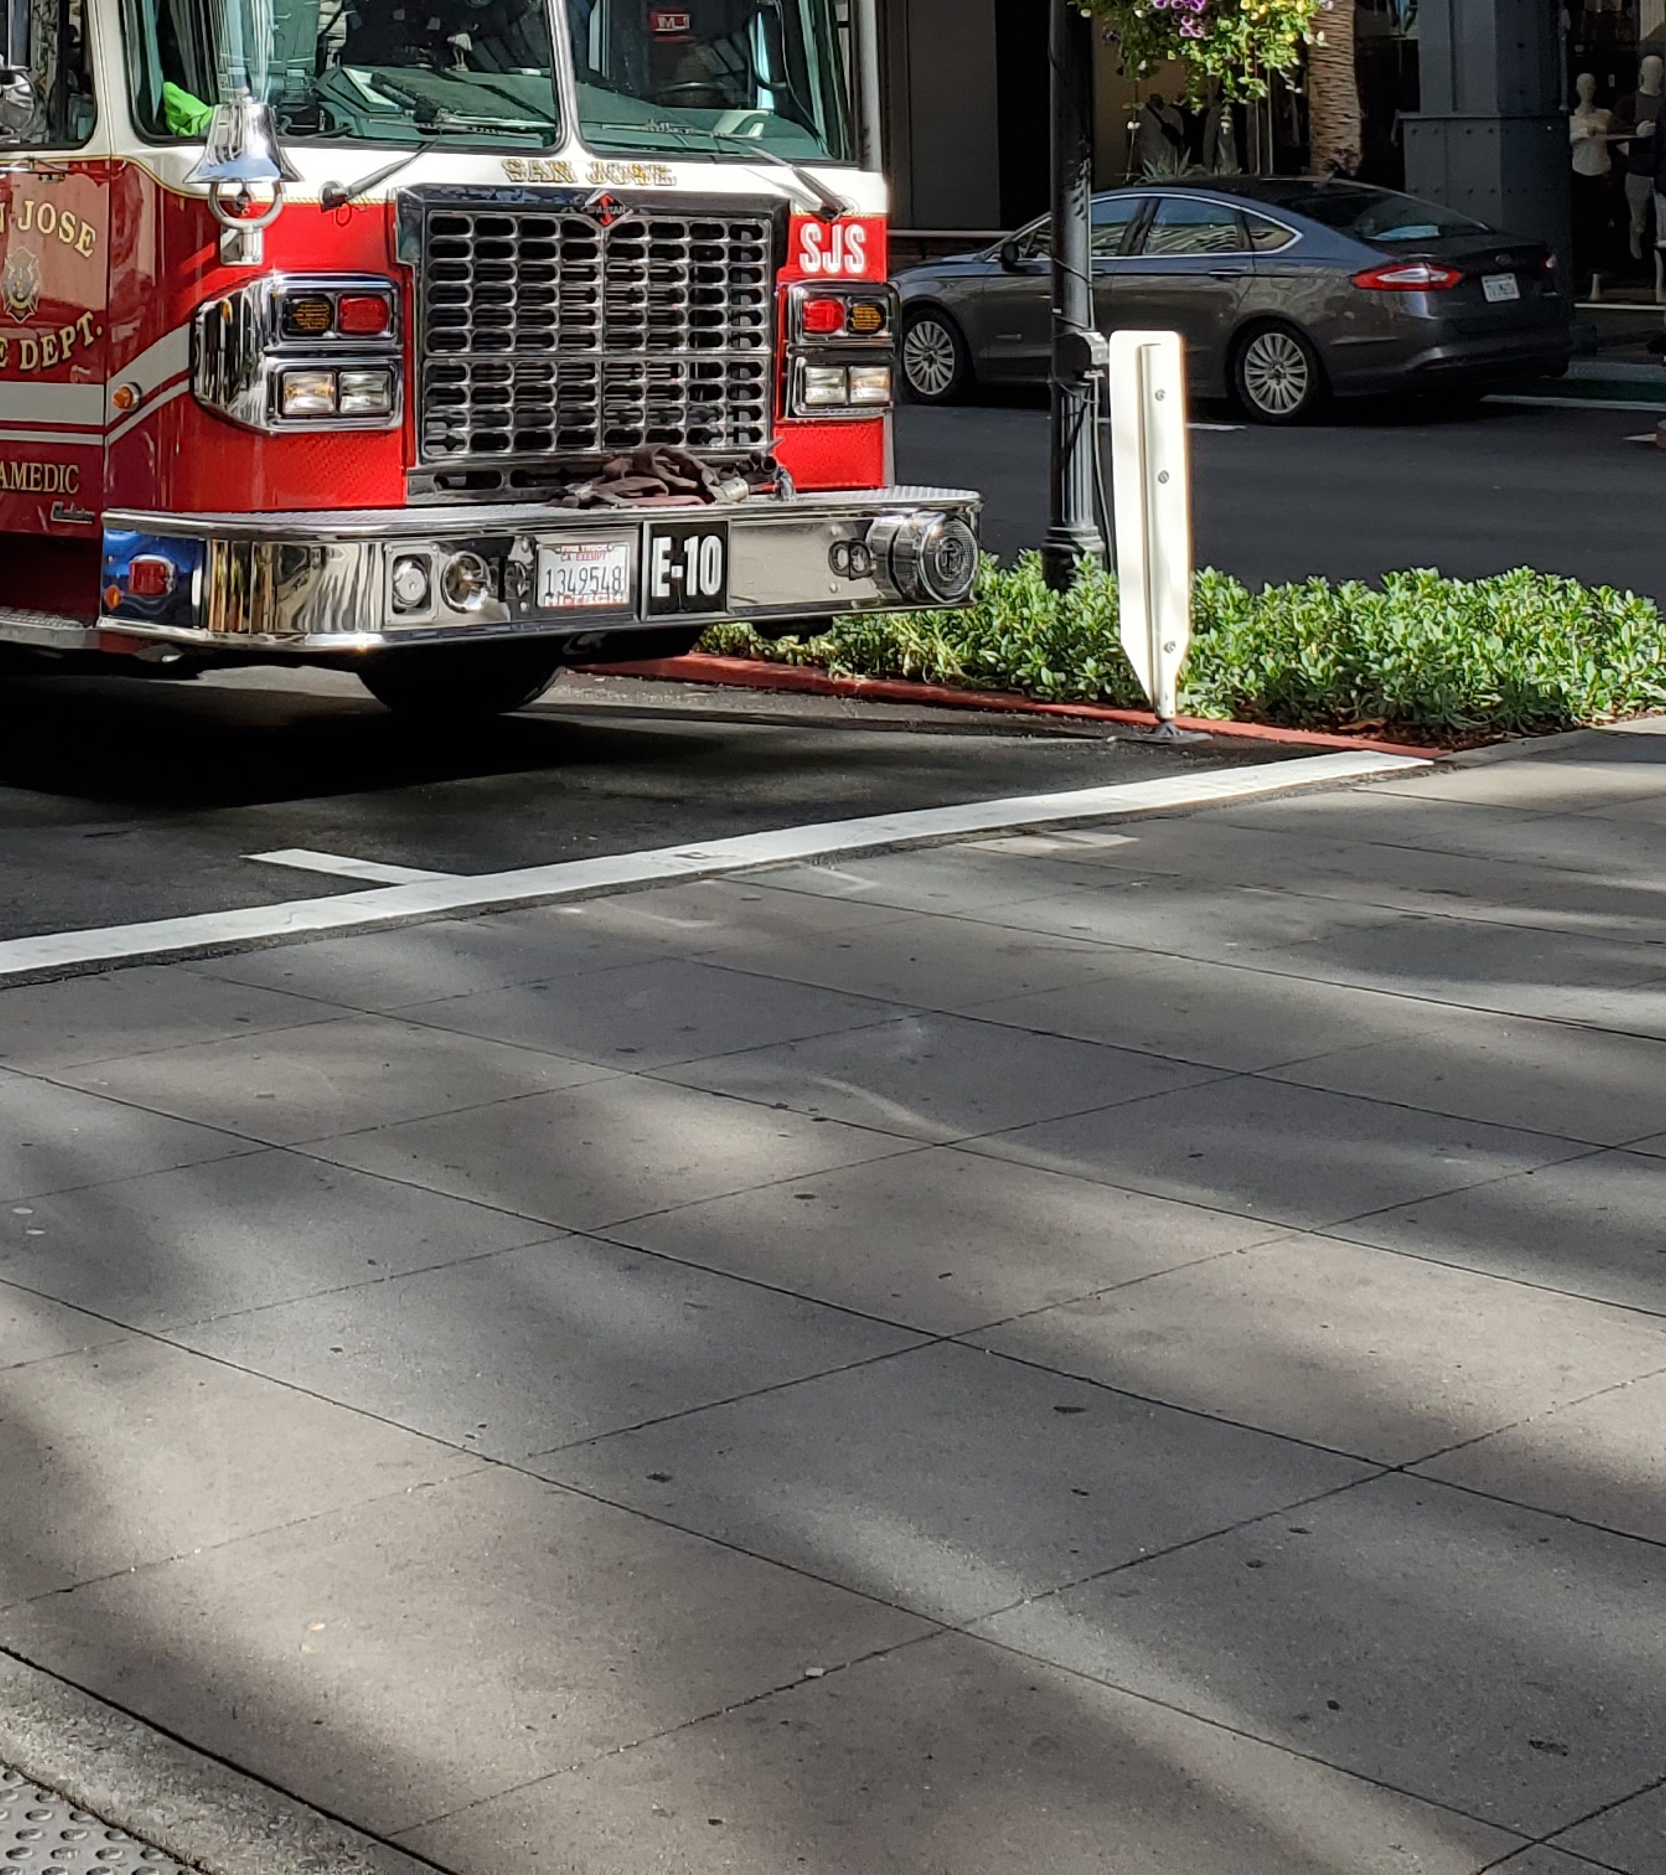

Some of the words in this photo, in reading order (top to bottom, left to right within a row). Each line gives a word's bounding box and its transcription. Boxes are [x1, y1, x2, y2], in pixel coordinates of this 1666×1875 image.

[502, 159, 577, 184] SAN
[585, 160, 676, 186] JOSE
[17, 200, 97, 259] JOSE
[798, 222, 866, 274] SJS
[19, 310, 103, 371] DEPT.
[544, 565, 623, 597] 1349548
[651, 535, 723, 598] E-10
